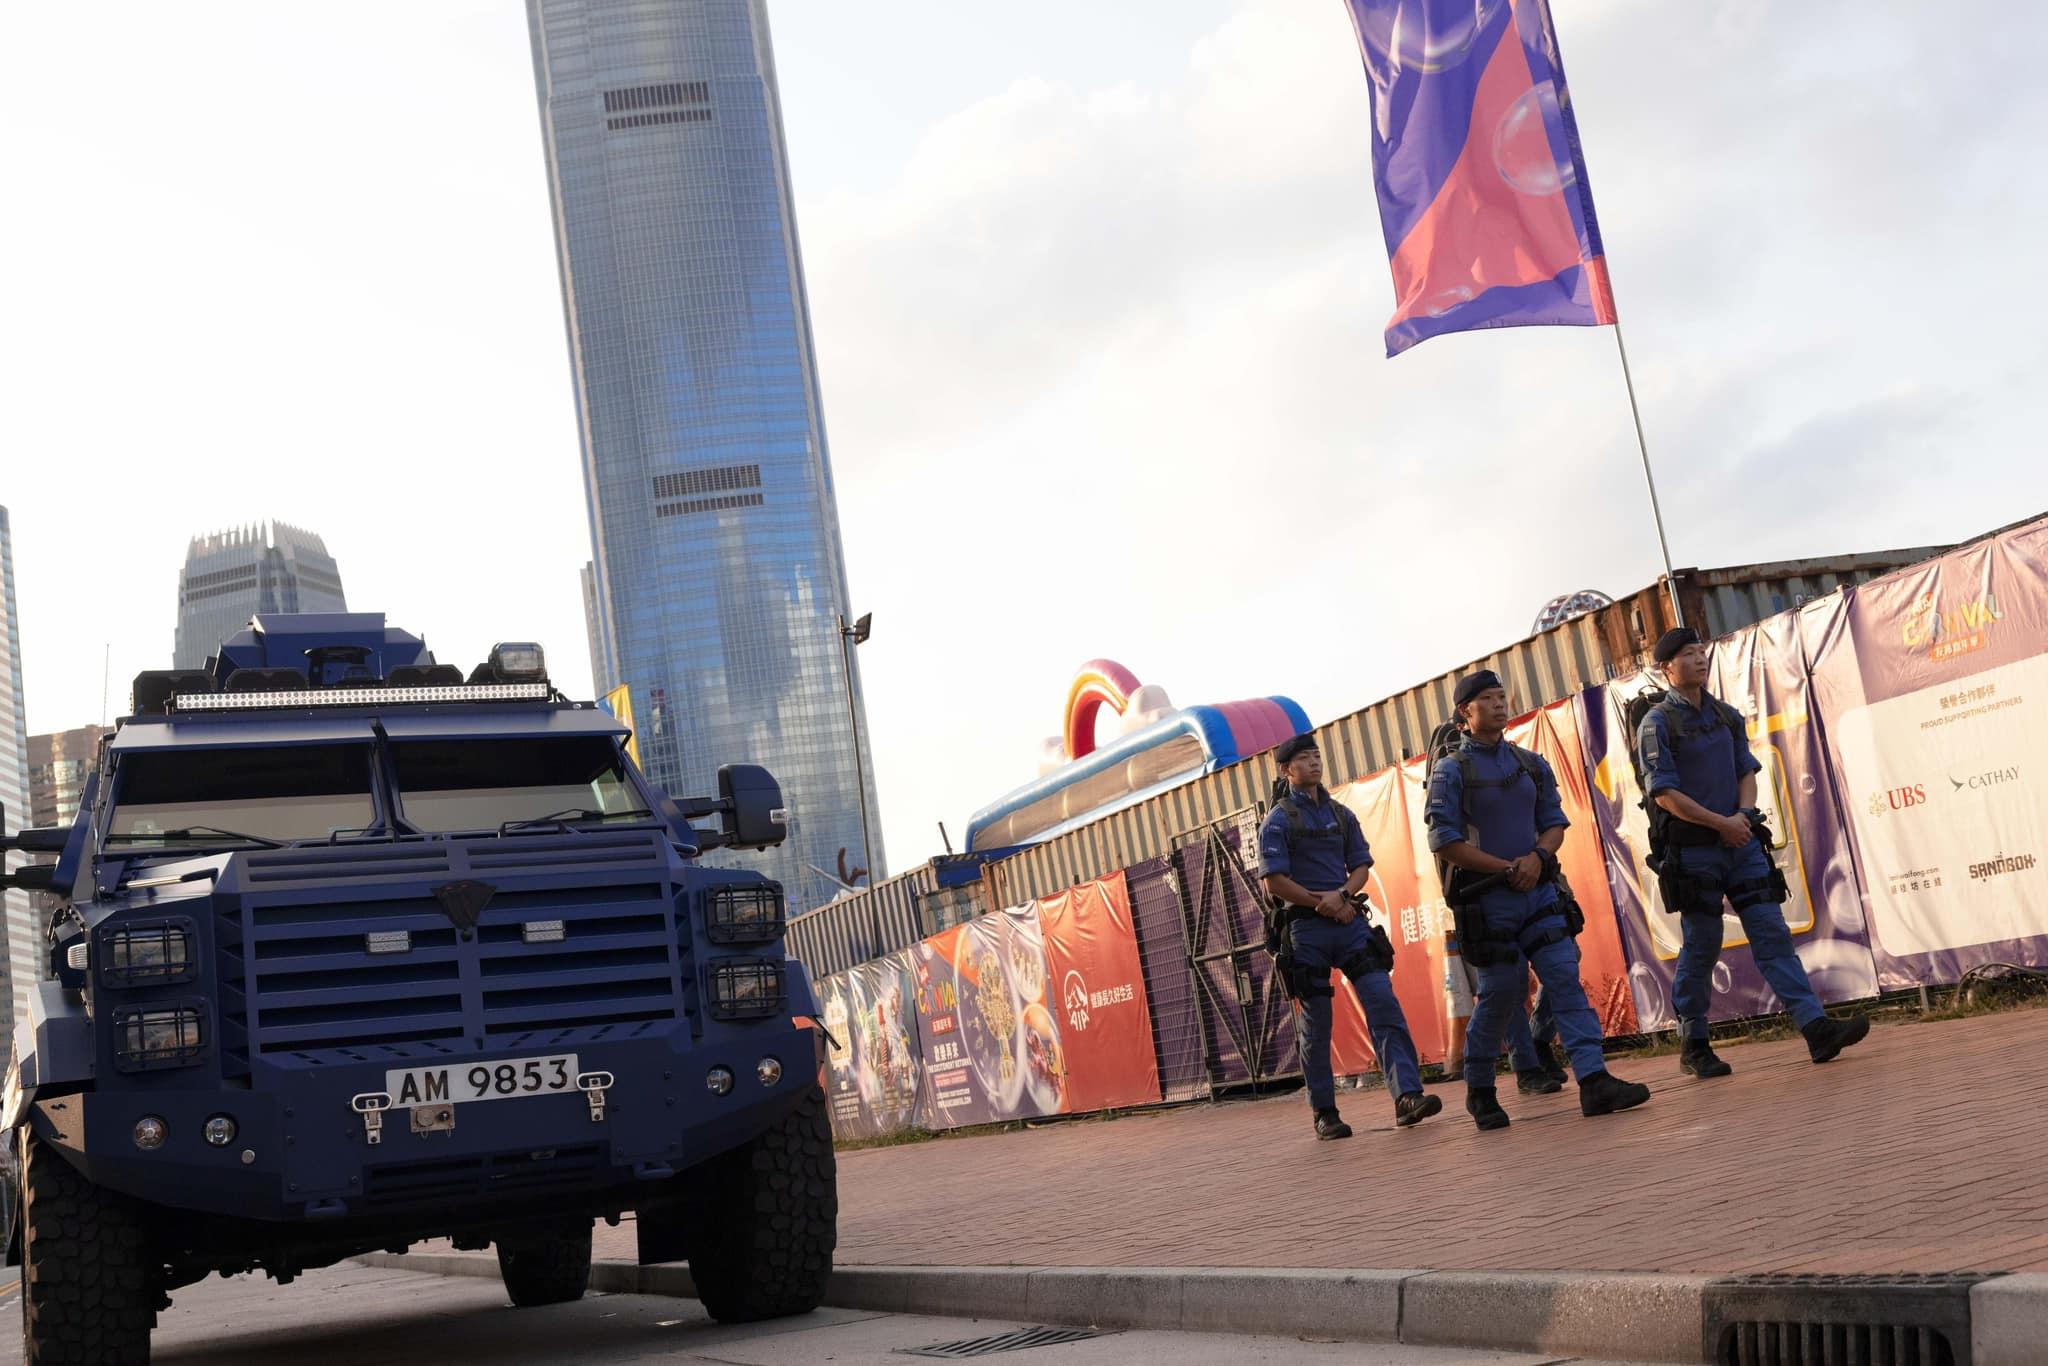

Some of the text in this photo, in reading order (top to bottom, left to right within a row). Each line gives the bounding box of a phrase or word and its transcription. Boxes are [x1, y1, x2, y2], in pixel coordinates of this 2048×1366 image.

[1944, 706, 1988, 724] SUPPORTING
[1987, 696, 2023, 712] PARTNERS
[1968, 765, 2020, 789] CATHAY
[1887, 783, 1926, 810] UBS
[1070, 1009, 1090, 1031] AIA
[399, 1059, 568, 1104] AM 9853
